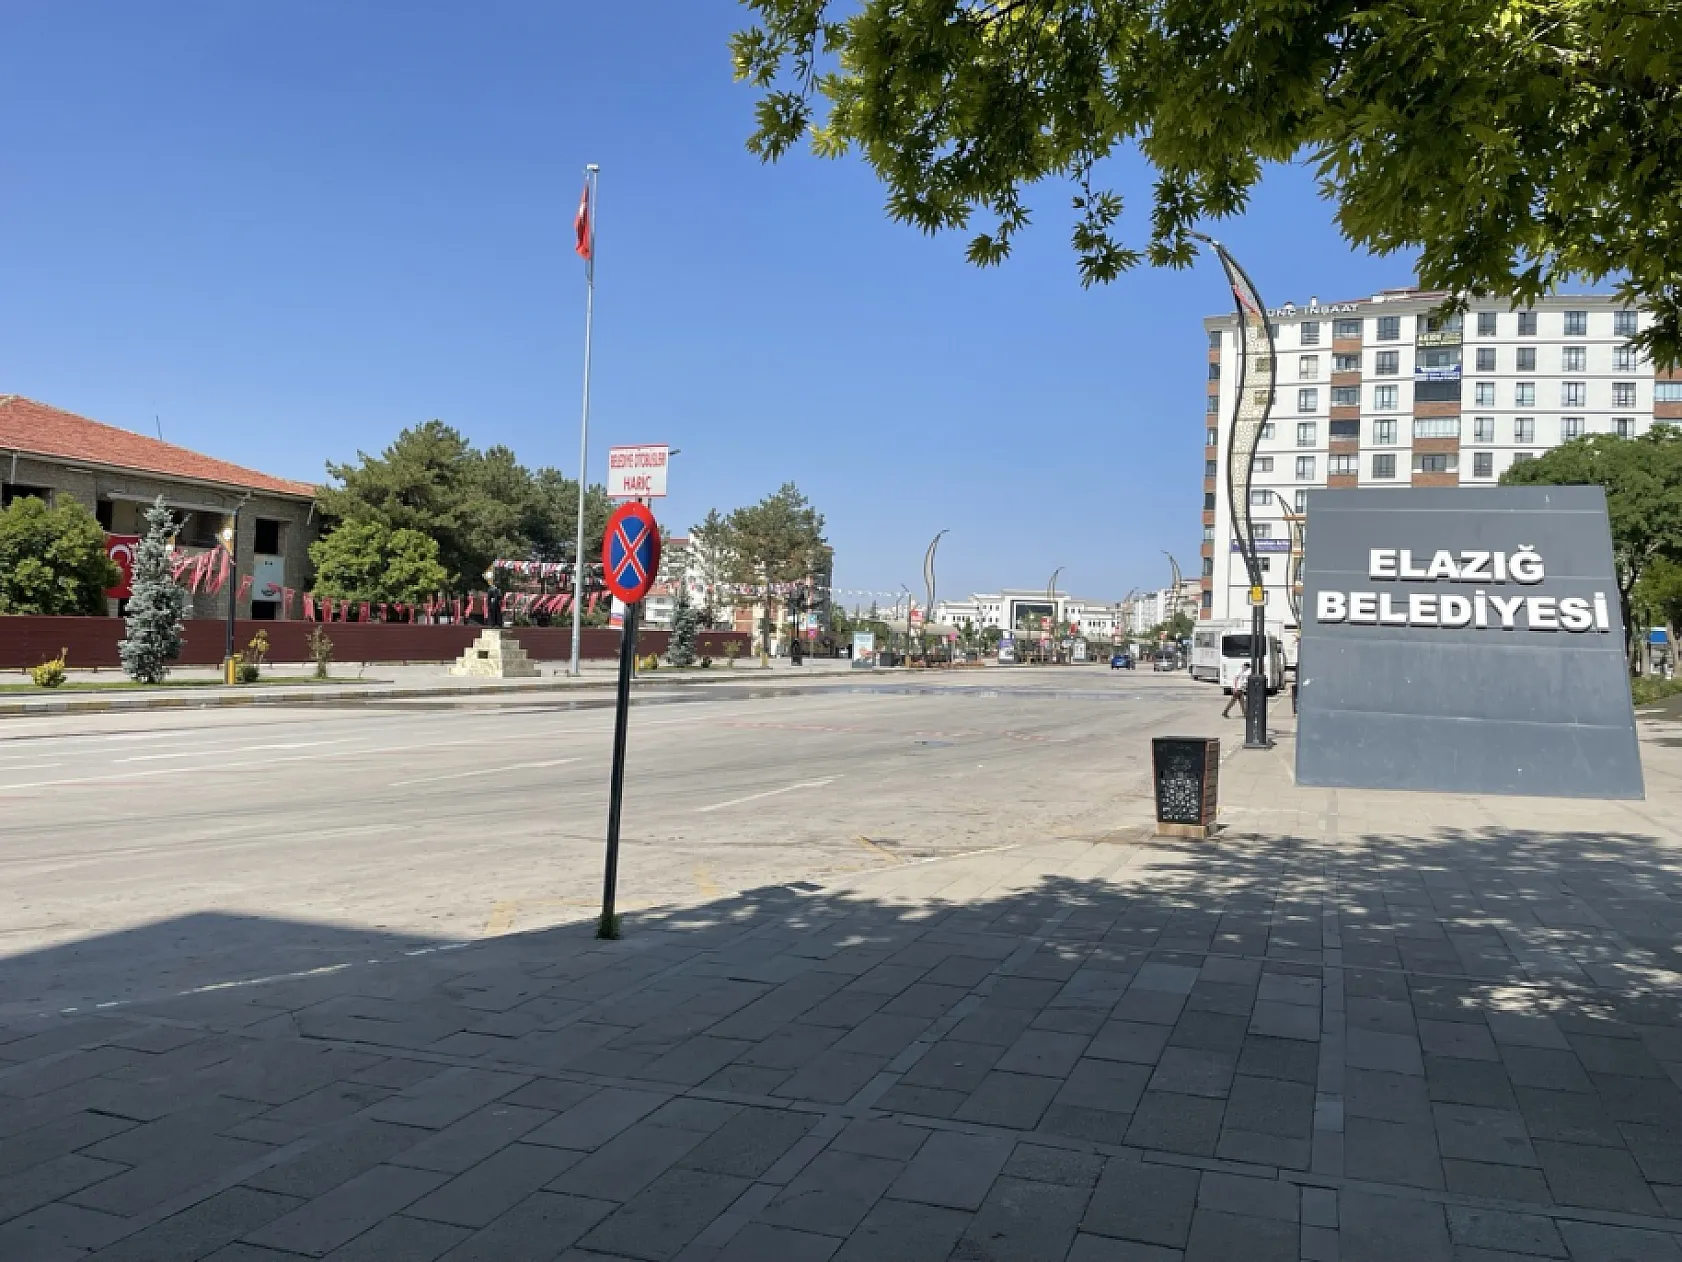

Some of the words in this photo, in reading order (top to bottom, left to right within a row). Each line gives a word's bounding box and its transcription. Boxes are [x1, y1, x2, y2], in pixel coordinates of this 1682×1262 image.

[623, 473, 652, 495] HARİÇ
[1369, 544, 1545, 584] ELAZIĞ
[1317, 590, 1610, 633] BELEDİYESİ
